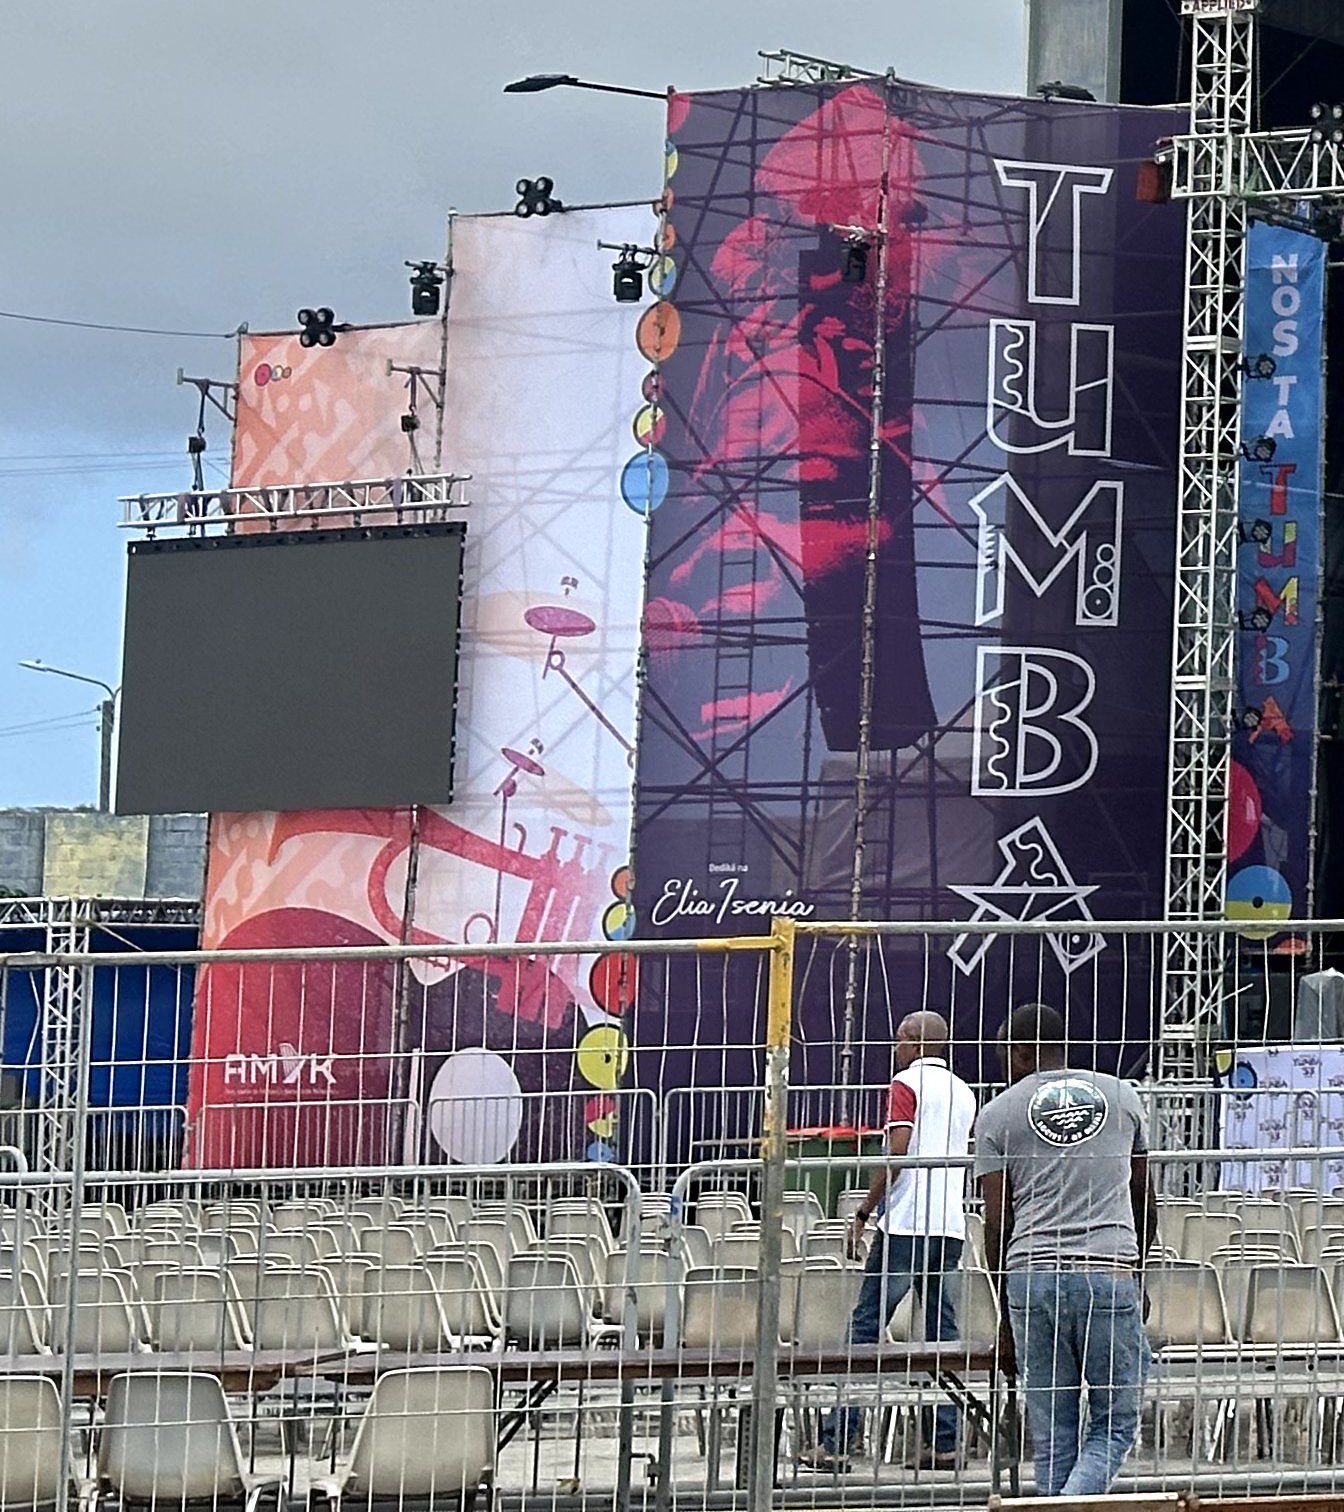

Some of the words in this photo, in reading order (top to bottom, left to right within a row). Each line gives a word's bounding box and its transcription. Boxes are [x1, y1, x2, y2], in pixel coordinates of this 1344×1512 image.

[1270, 253, 1298, 357] NOS
[1266, 376, 1297, 440] TA
[947, 159, 1123, 975] TUMBA
[1248, 463, 1298, 744] TUMBA
[652, 879, 715, 926] Elia
[715, 879, 815, 924] Isenia
